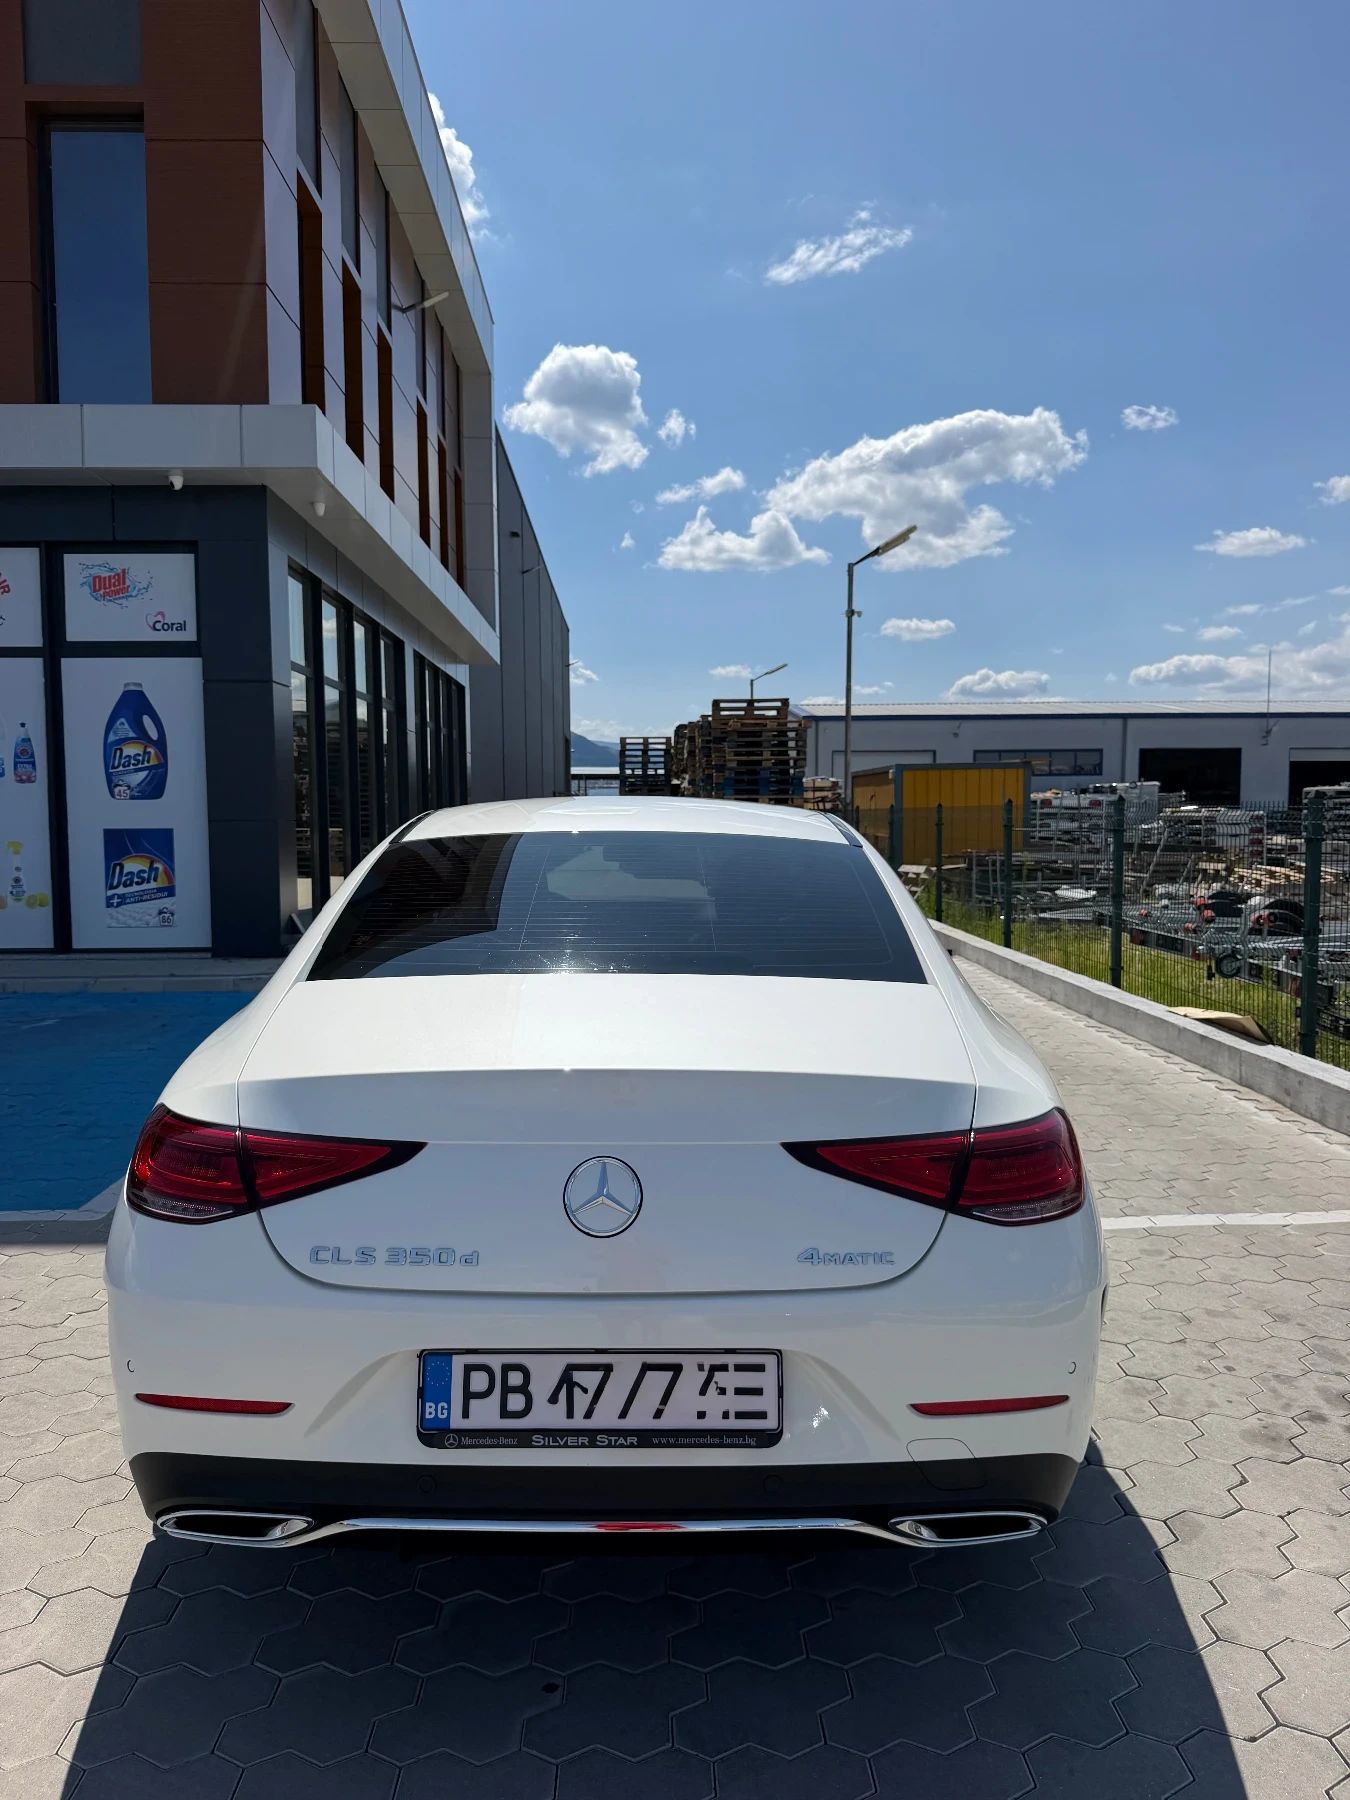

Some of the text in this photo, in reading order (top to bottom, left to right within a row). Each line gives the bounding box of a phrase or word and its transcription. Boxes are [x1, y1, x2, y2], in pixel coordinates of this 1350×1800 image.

[92, 568, 127, 593] Dual
[152, 620, 187, 632] Coral
[110, 745, 152, 770] Dash
[116, 789, 129, 799] 45
[108, 860, 160, 891] Dash
[161, 915, 172, 924] 86
[309, 1246, 377, 1265] CLS
[796, 1247, 896, 1266] 4MATIC
[424, 1401, 449, 1419] BG
[461, 1435, 518, 1447] Mercedes-Benz
[531, 1434, 639, 1447] SILVER STAR
[651, 1434, 757, 1448] www.mercedes-benz.bg
